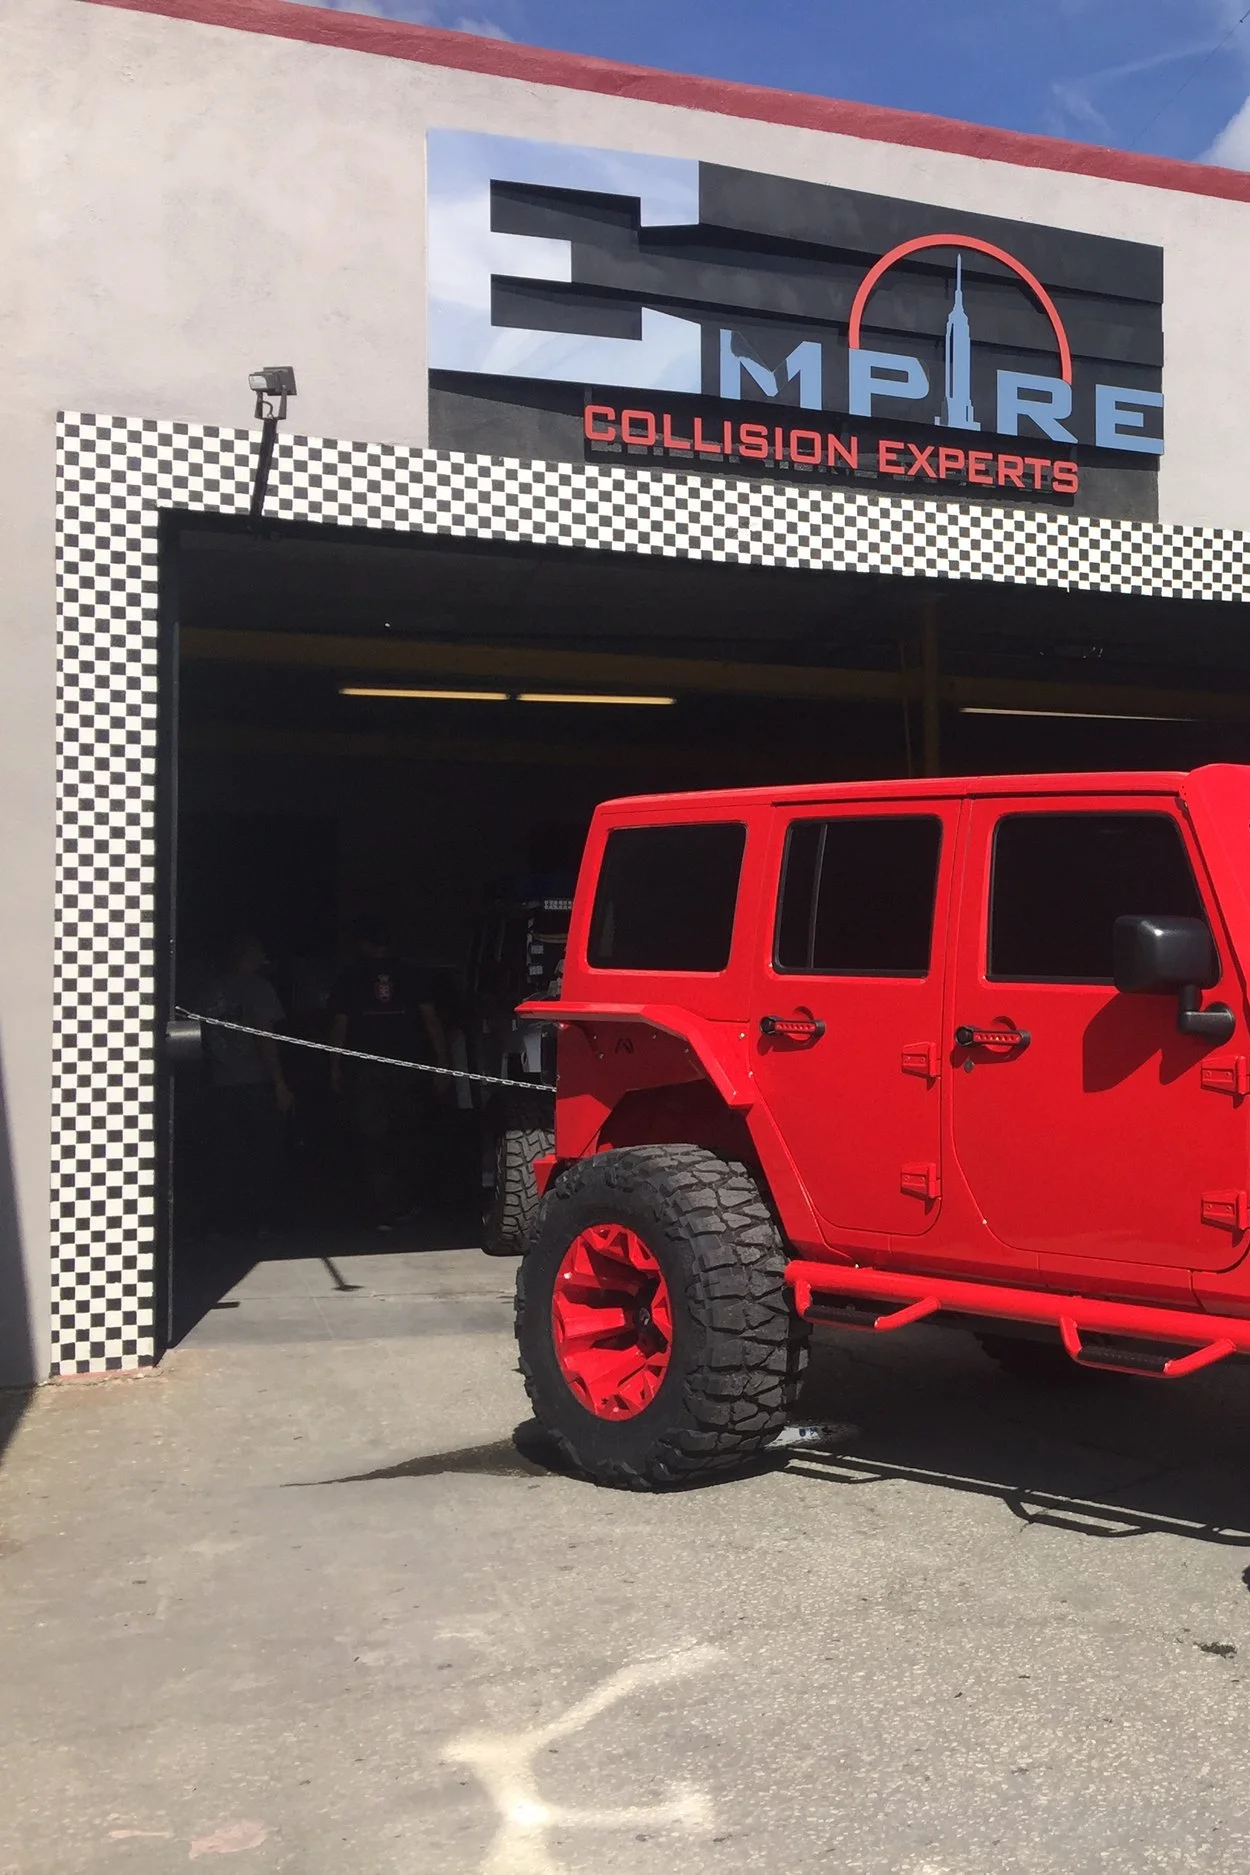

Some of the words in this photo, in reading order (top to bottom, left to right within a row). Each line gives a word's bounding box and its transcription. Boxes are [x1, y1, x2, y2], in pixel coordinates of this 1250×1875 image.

[427, 127, 1164, 455] EMPIRE
[584, 404, 859, 468] COLLISION
[878, 439, 1079, 494] EXPERTS
